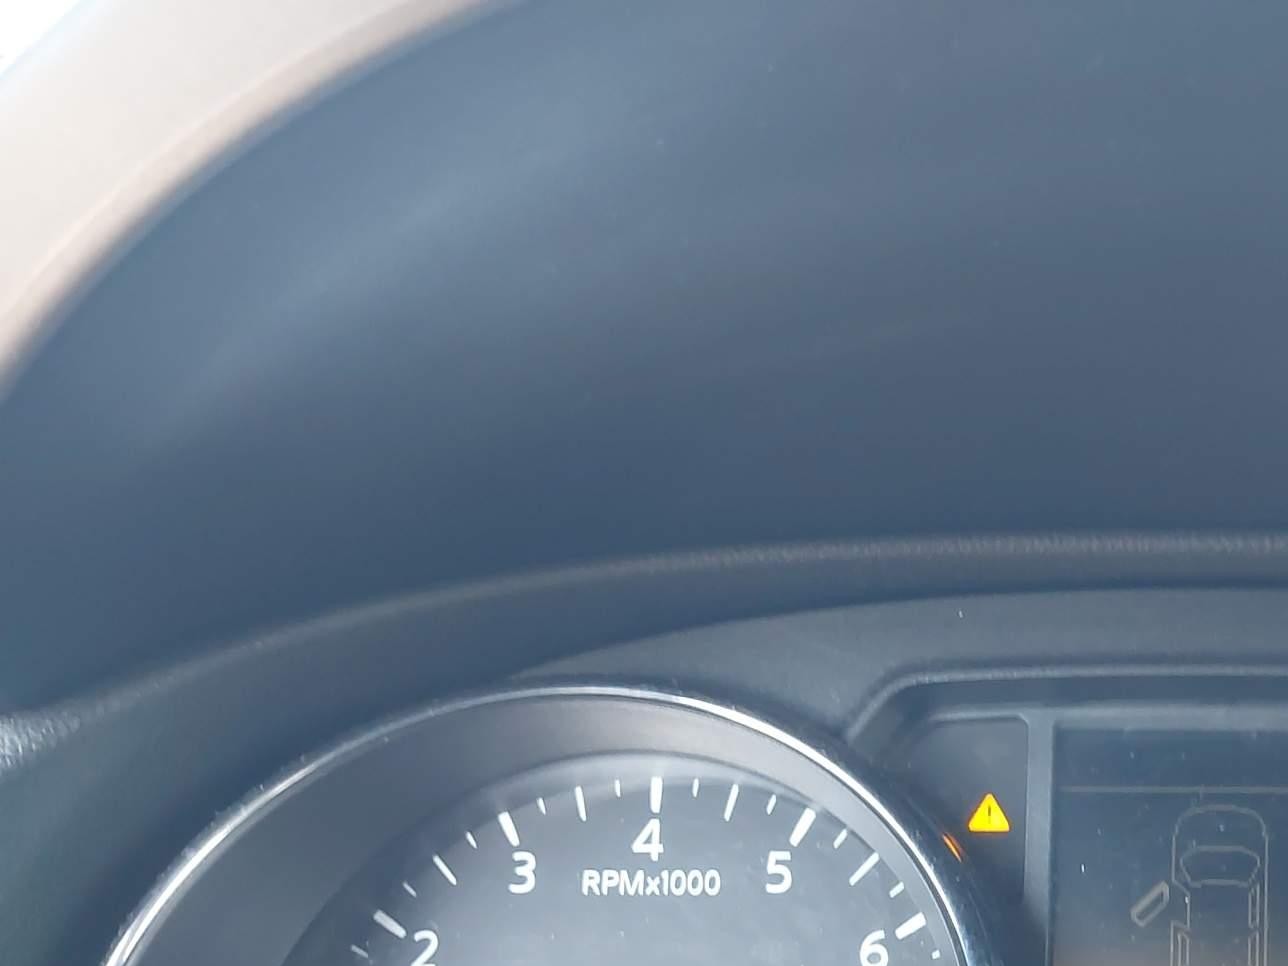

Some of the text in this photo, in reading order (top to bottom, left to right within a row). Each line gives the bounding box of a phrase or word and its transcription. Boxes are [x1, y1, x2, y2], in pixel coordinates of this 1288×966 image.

[632, 818, 664, 862] 4
[508, 851, 537, 894] 3
[581, 869, 721, 896] RPMx1000
[765, 850, 793, 894] 5
